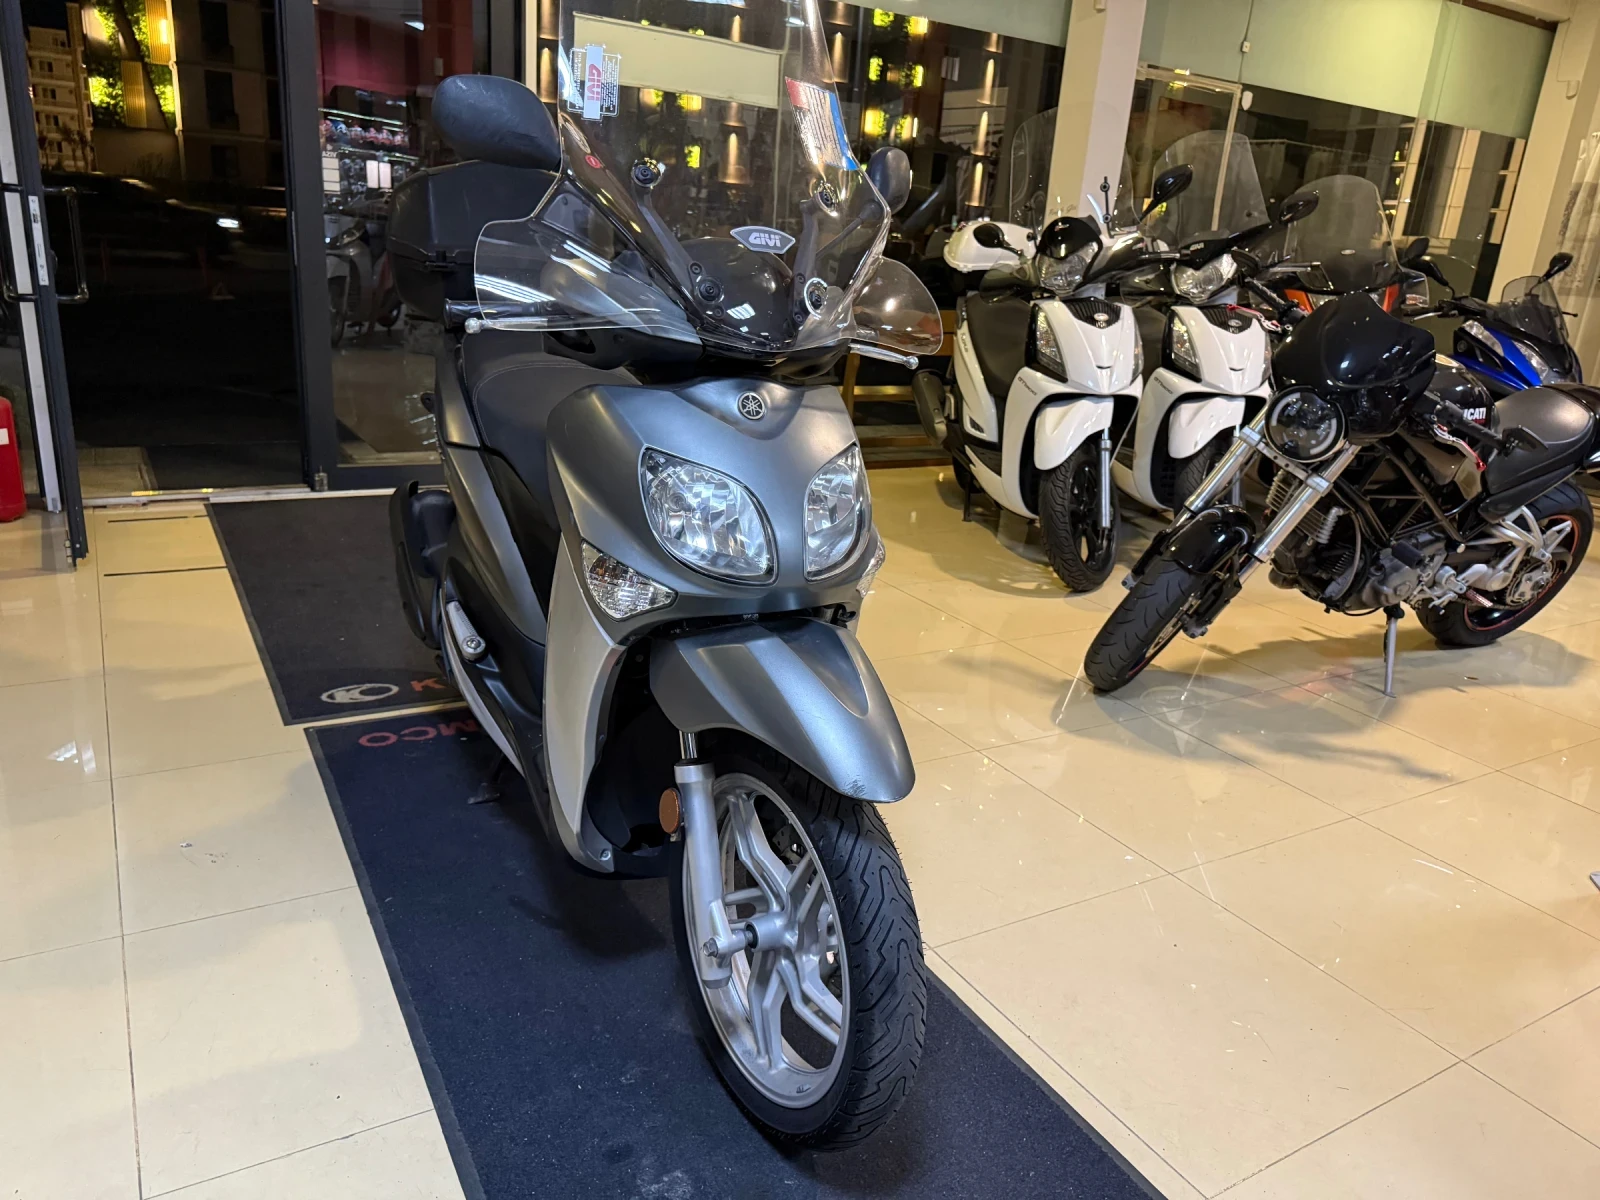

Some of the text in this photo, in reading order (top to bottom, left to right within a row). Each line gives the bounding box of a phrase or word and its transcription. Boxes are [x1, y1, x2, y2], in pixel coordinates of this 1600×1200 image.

[587, 64, 602, 101] GIVI
[749, 232, 781, 247] GIVI
[1463, 407, 1486, 420] CATI
[358, 719, 479, 747] MCO
